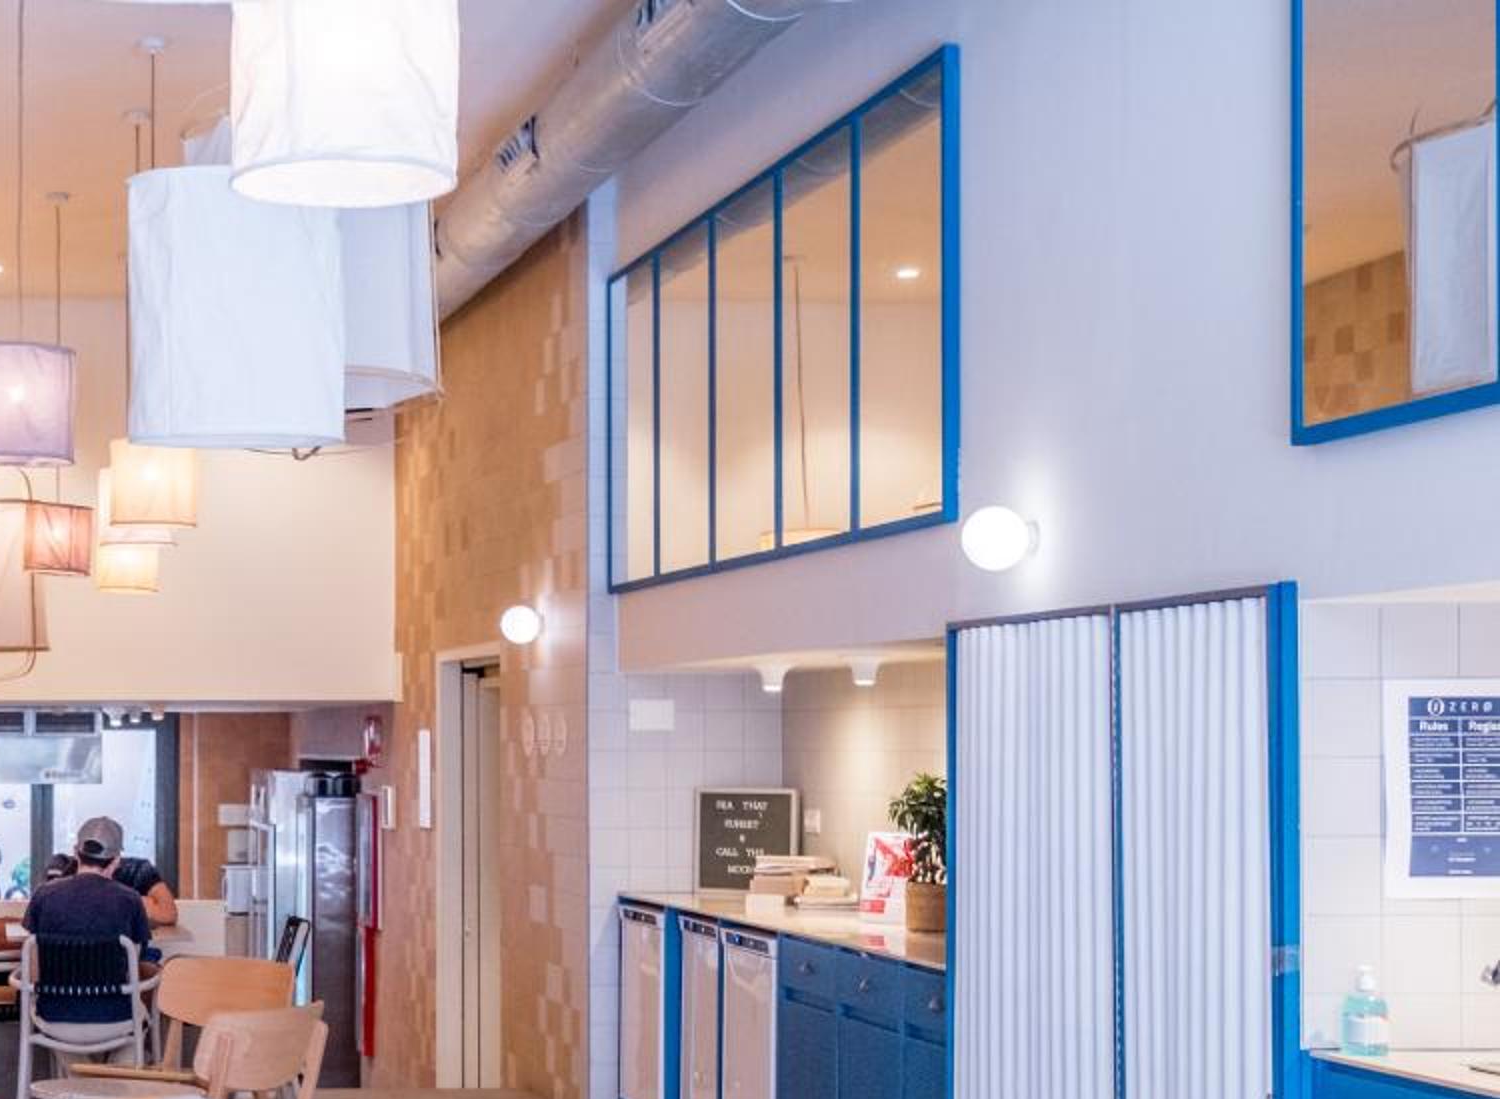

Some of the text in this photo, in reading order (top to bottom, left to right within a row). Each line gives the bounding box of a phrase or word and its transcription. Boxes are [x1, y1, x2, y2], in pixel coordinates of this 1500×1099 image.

[1419, 721, 1449, 731] Rules
[742, 800, 768, 811] THAT
[715, 847, 739, 857] CALL
